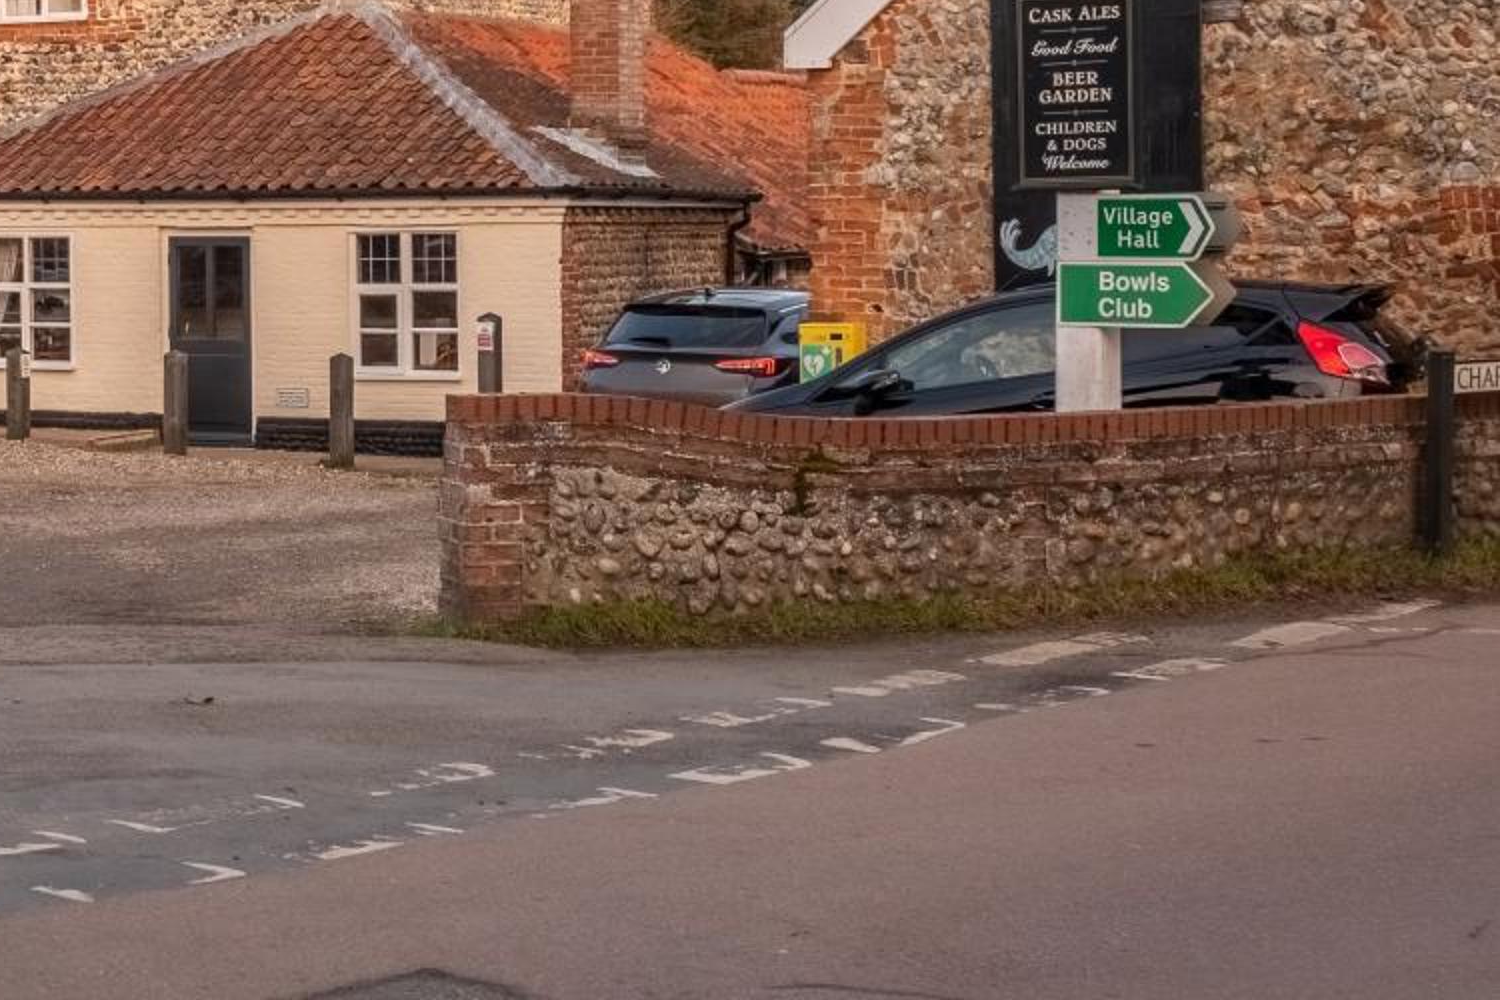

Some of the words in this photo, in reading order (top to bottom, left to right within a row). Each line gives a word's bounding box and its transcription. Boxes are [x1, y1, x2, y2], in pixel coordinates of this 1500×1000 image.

[1028, 7, 1072, 24] CASK
[1078, 5, 1121, 21] ALES
[1031, 39, 1073, 57] Good
[1073, 36, 1119, 55] Food
[1052, 71, 1099, 87] BEER
[1038, 87, 1112, 105] GARDEN
[1035, 120, 1117, 135] CHILDREN
[1047, 139, 1057, 151] &
[1063, 137, 1108, 151] DOGS
[1041, 153, 1110, 171] Welcome
[1103, 207, 1174, 229] Village
[1117, 229, 1160, 249] Hall
[1099, 270, 1171, 292] Bowls
[1098, 297, 1153, 319] Club
